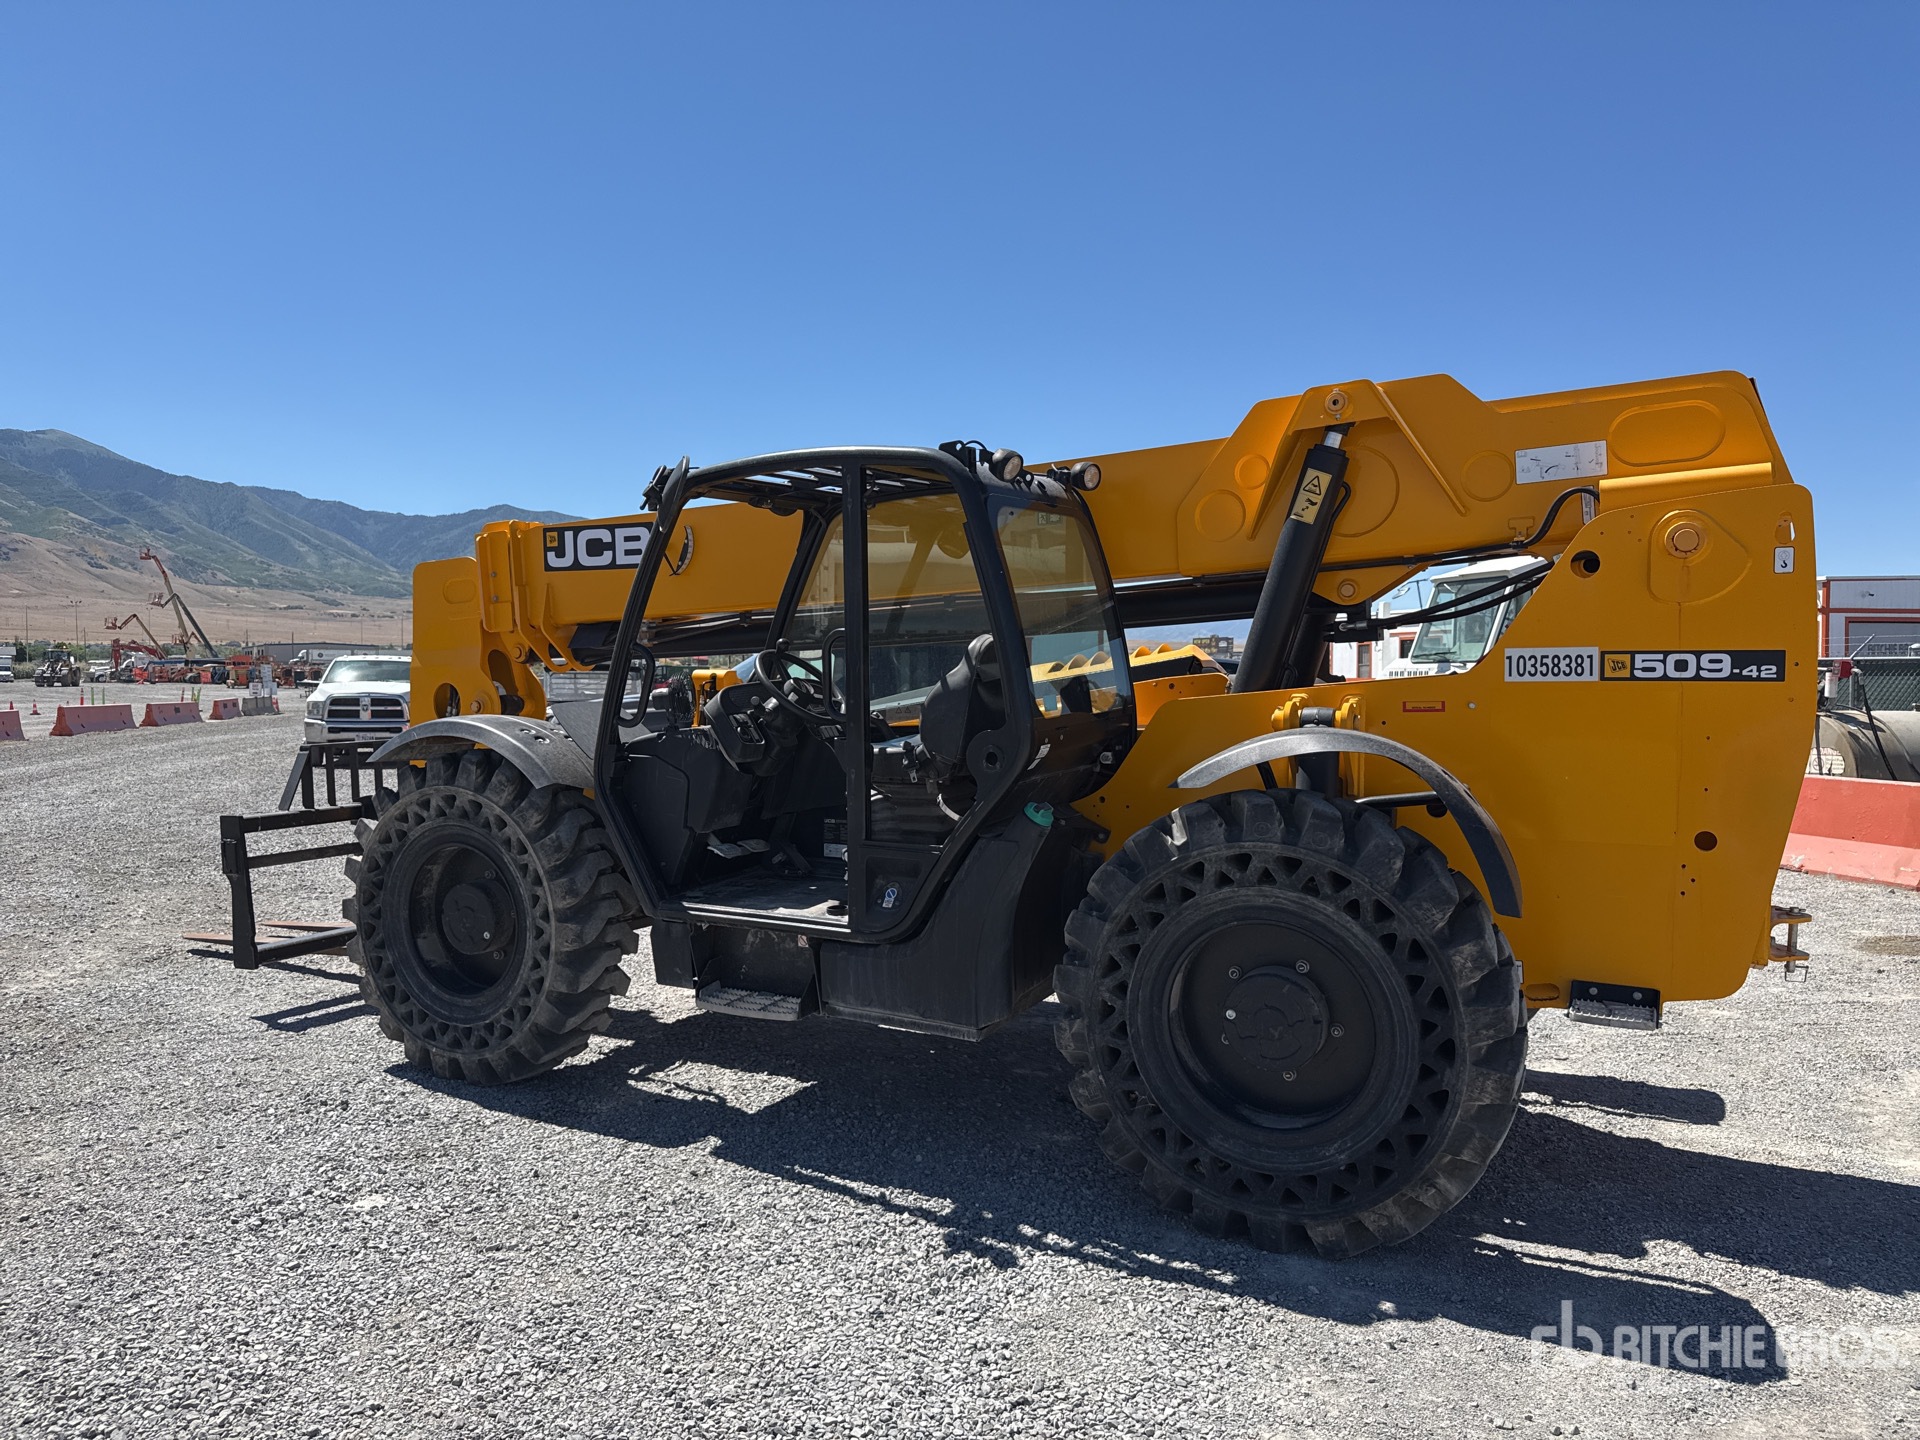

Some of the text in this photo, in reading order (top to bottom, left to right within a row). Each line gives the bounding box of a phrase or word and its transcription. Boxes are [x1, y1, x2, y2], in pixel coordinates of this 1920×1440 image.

[546, 526, 650, 568] JCB
[1505, 654, 1595, 677] 10358381
[1611, 653, 1777, 678] JCB 509-42
